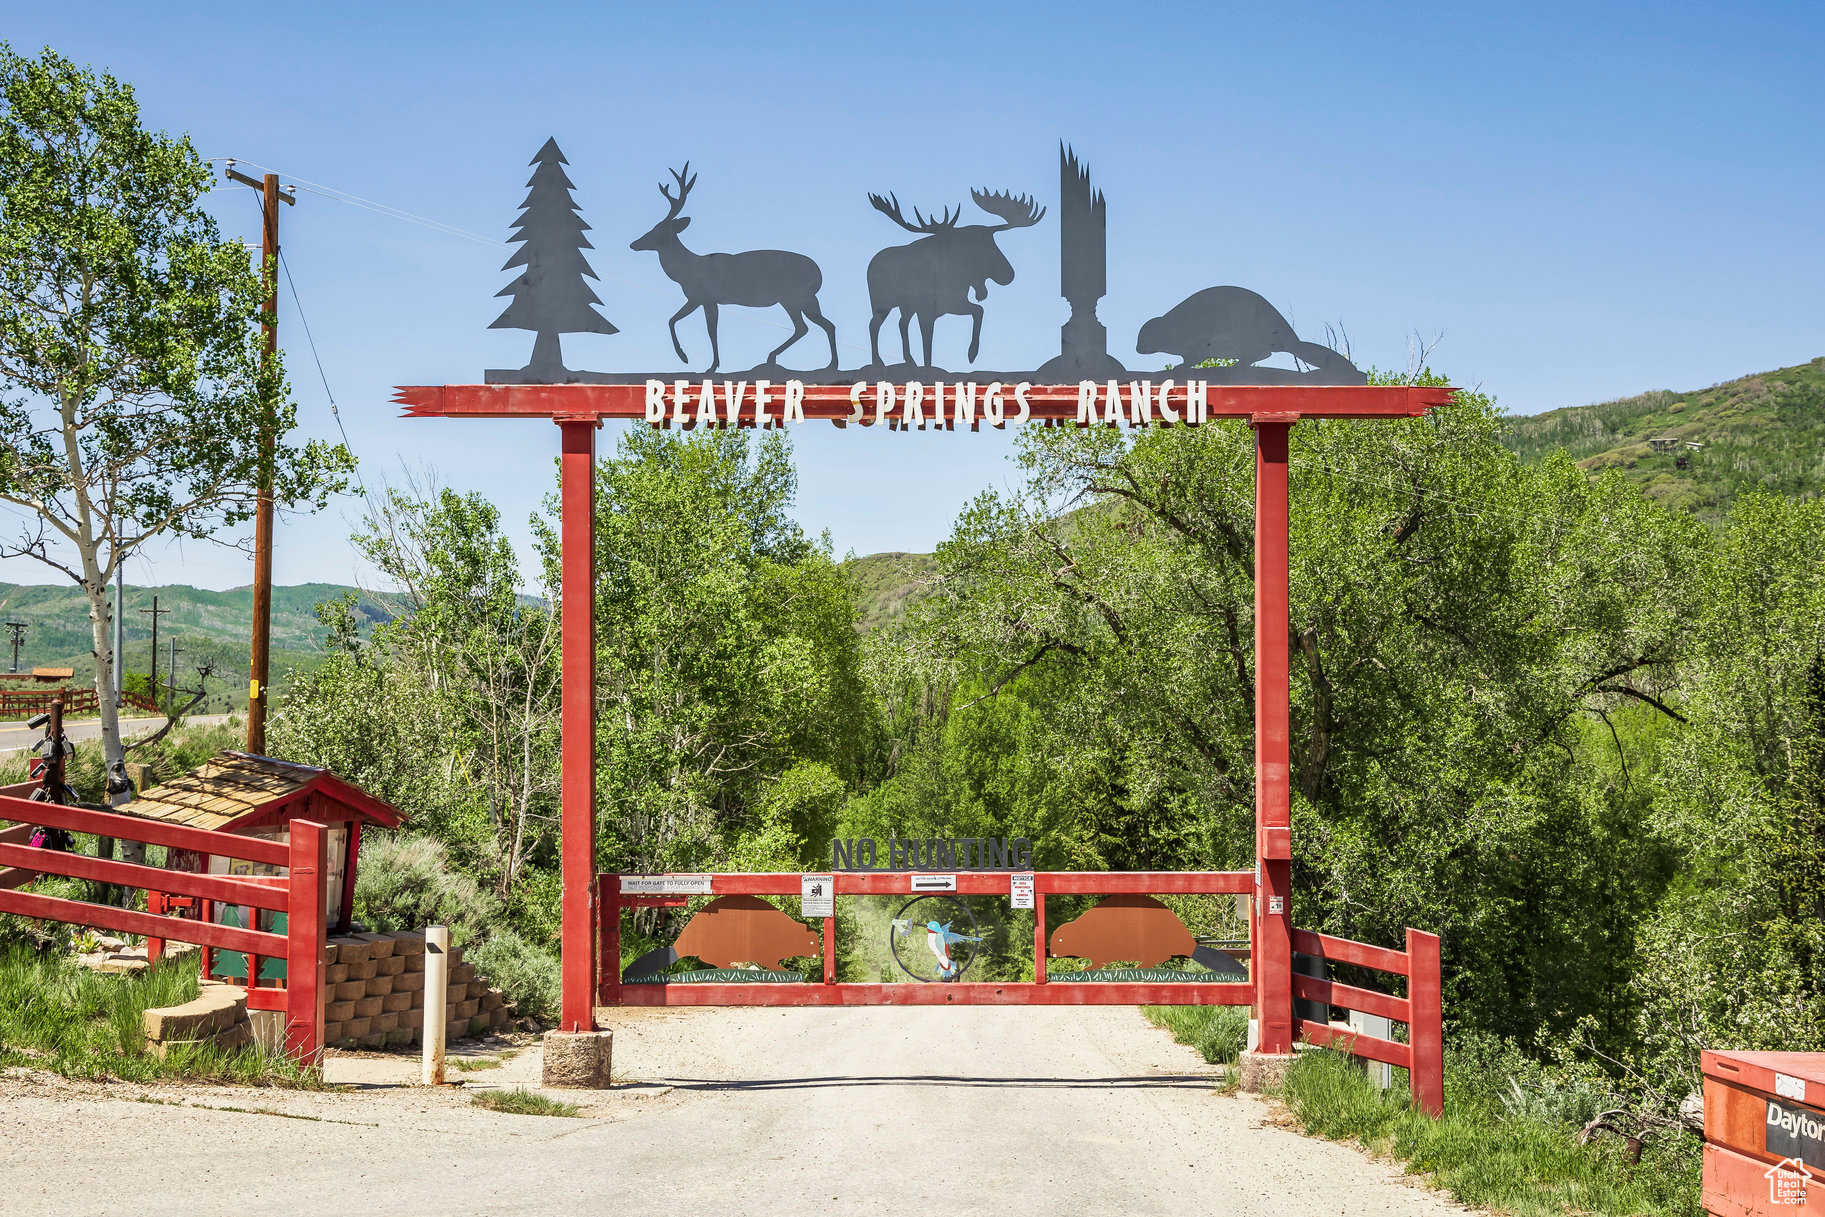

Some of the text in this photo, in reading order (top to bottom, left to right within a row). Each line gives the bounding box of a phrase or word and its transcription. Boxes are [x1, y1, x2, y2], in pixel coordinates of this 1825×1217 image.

[645, 379, 1207, 426] BEAVER SPRINGS RANCH
[833, 837, 1032, 869] NO HUNTING
